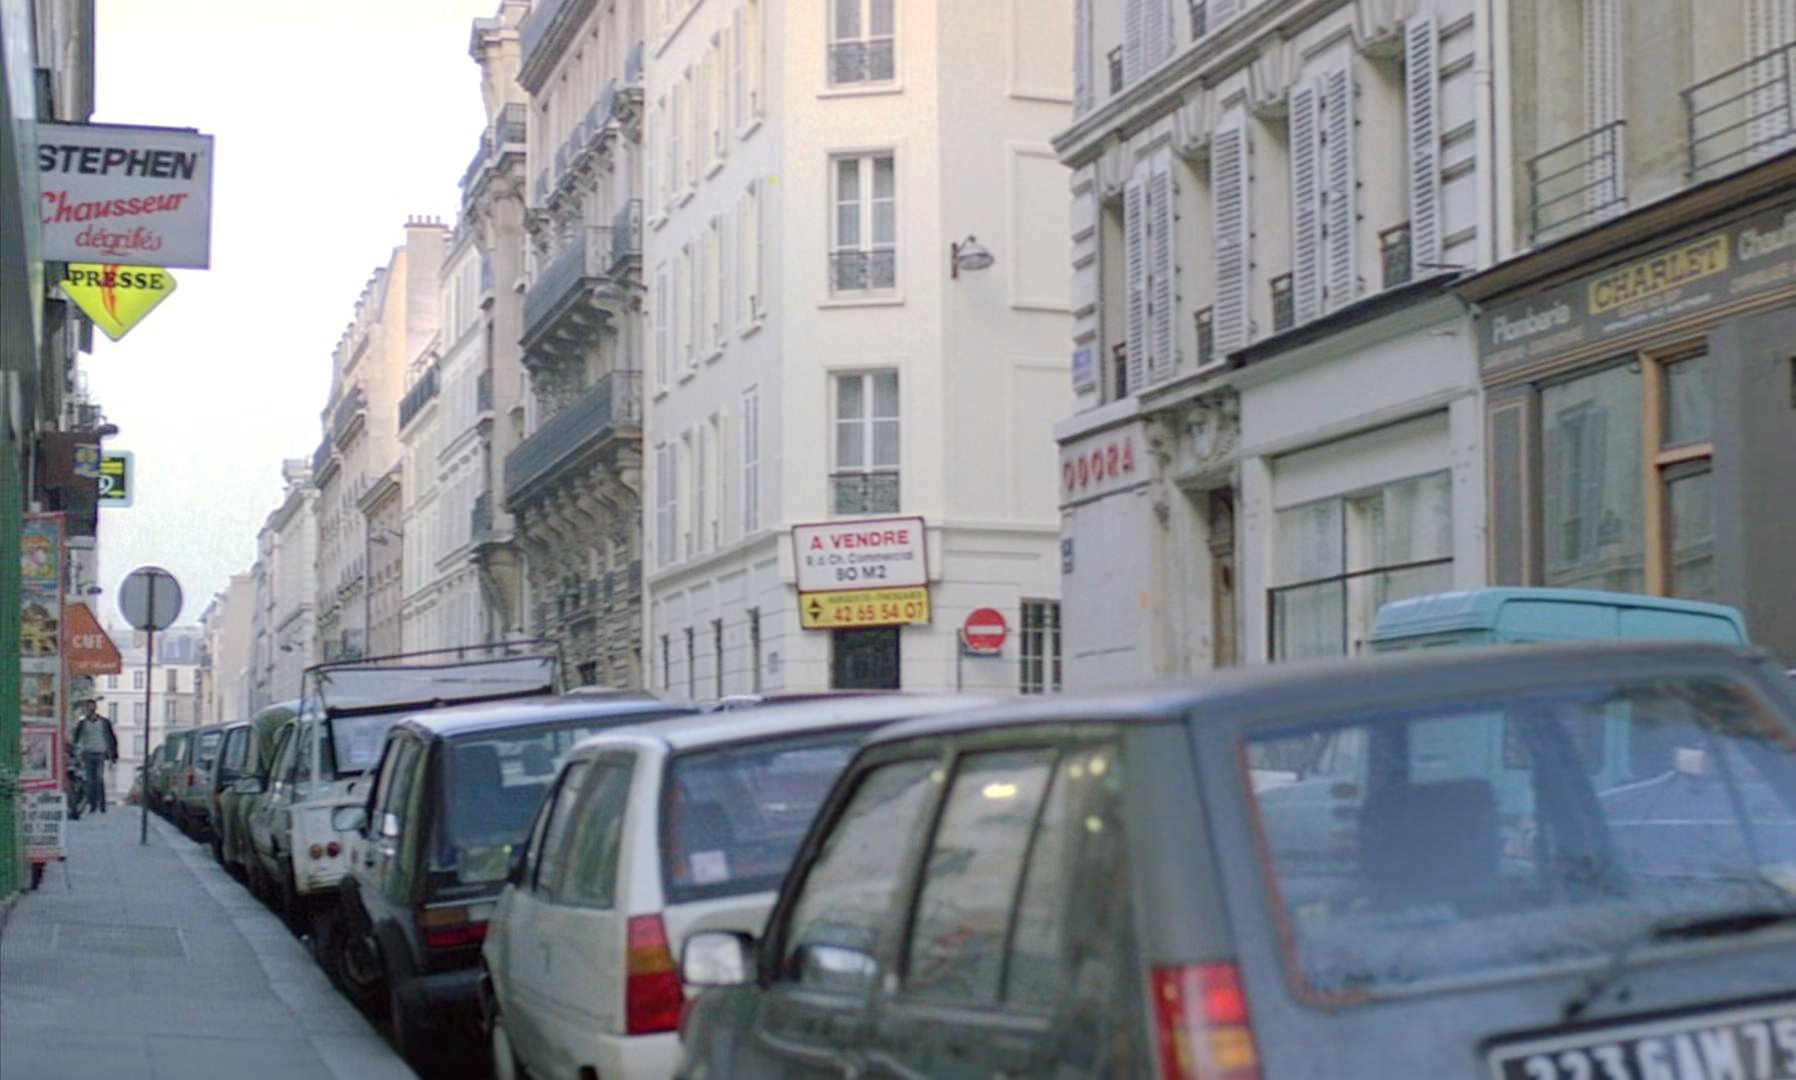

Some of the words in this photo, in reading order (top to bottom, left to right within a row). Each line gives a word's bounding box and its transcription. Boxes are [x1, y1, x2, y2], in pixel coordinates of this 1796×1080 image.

[38, 144, 198, 180] STEPHEN
[68, 270, 165, 290] PRESSE
[1594, 238, 1721, 308] CHARLET
[810, 535, 823, 551] A
[830, 530, 909, 548] VENDRE
